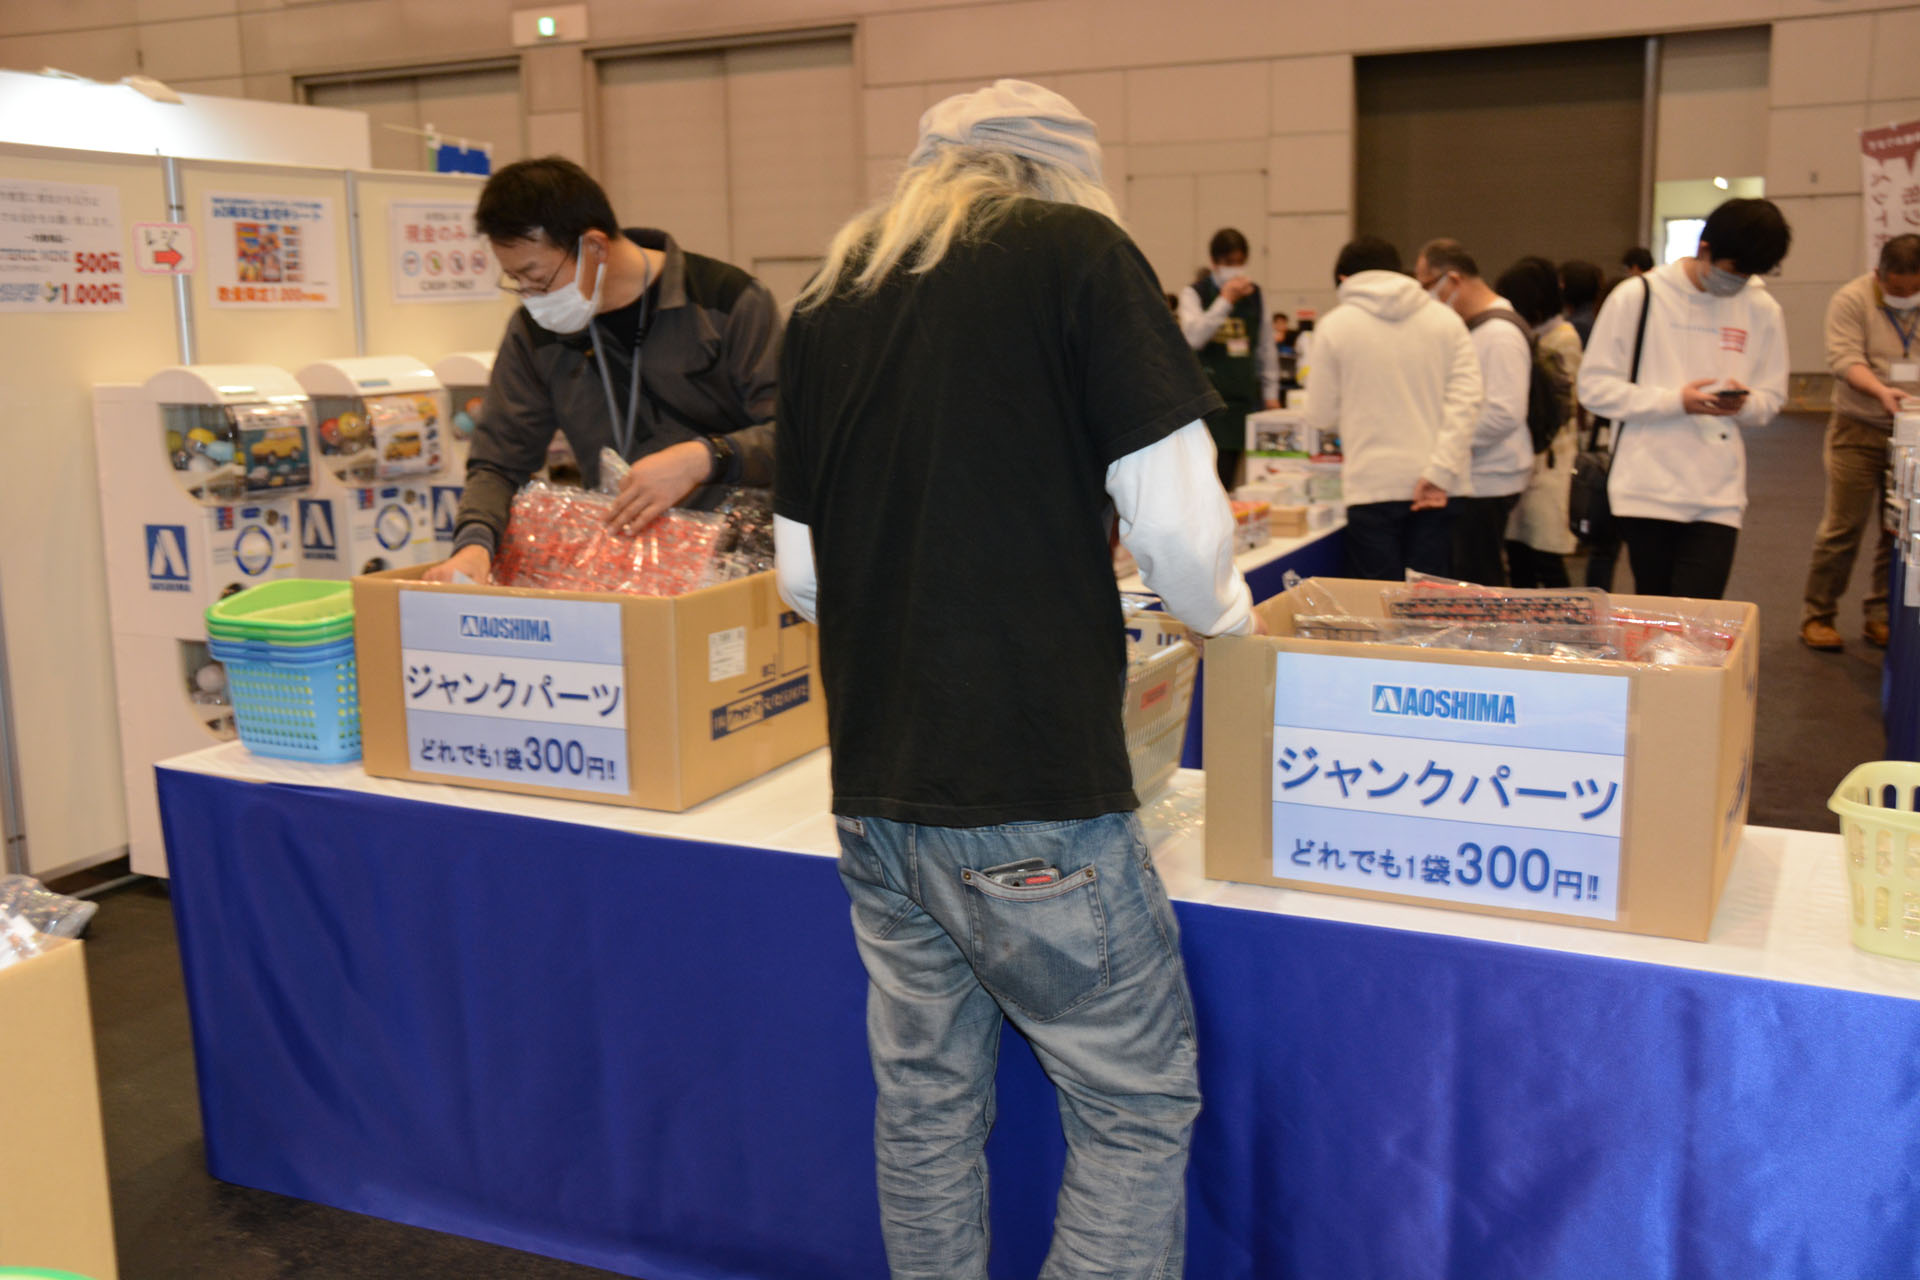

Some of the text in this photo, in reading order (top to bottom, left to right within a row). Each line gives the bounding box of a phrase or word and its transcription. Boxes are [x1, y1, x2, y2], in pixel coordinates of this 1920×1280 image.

[478, 616, 552, 642] AOSHIMA
[406, 664, 621, 717] ジャンクパーツ
[1402, 687, 1516, 724] AOSHIMA
[1277, 745, 1619, 820] ジャンクパーツ
